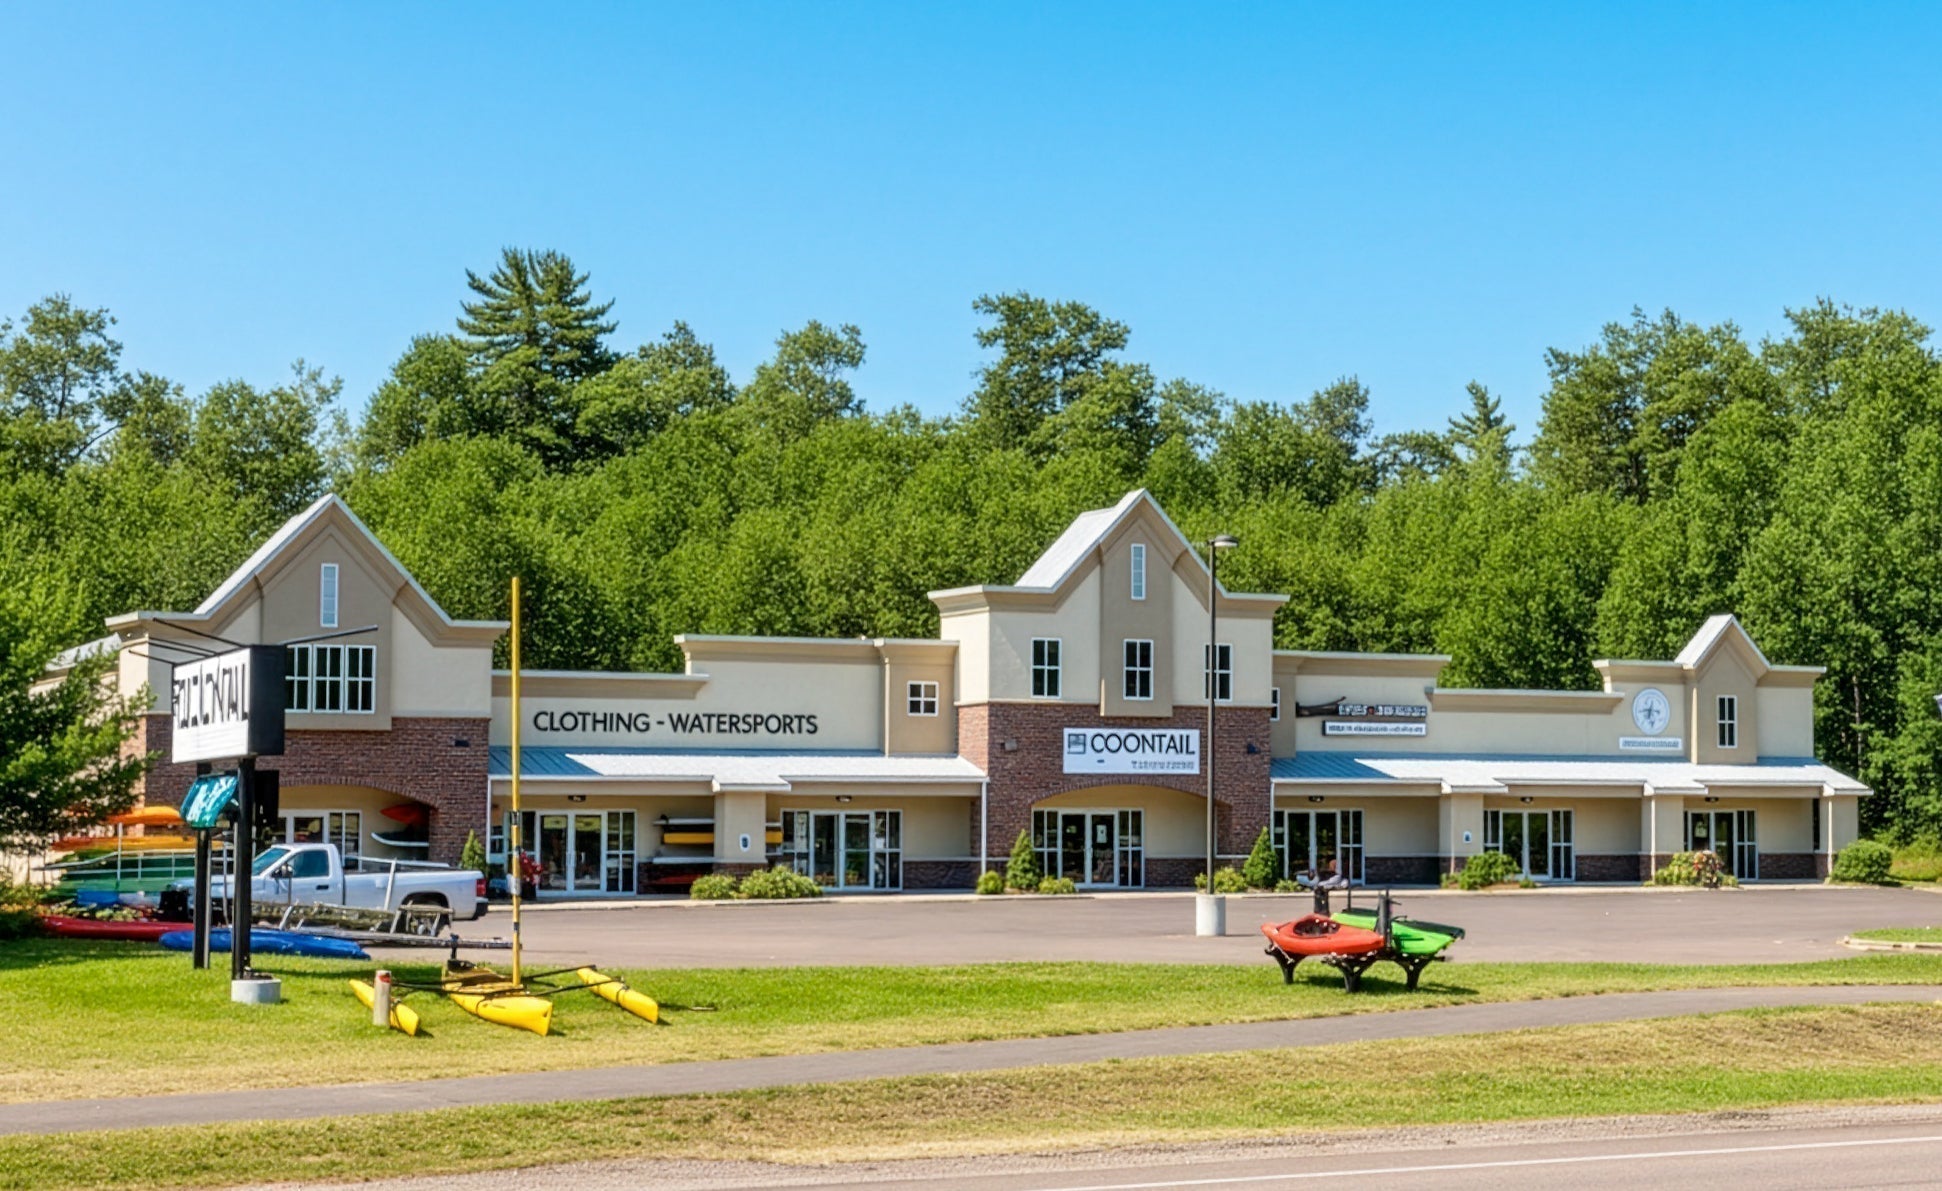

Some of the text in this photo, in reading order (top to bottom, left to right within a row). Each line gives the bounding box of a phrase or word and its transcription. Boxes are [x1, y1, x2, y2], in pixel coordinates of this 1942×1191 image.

[533, 711, 651, 733] CLOTHING
[668, 712, 818, 735] WATERSPORTS
[1090, 732, 1196, 755] COONTAIL
